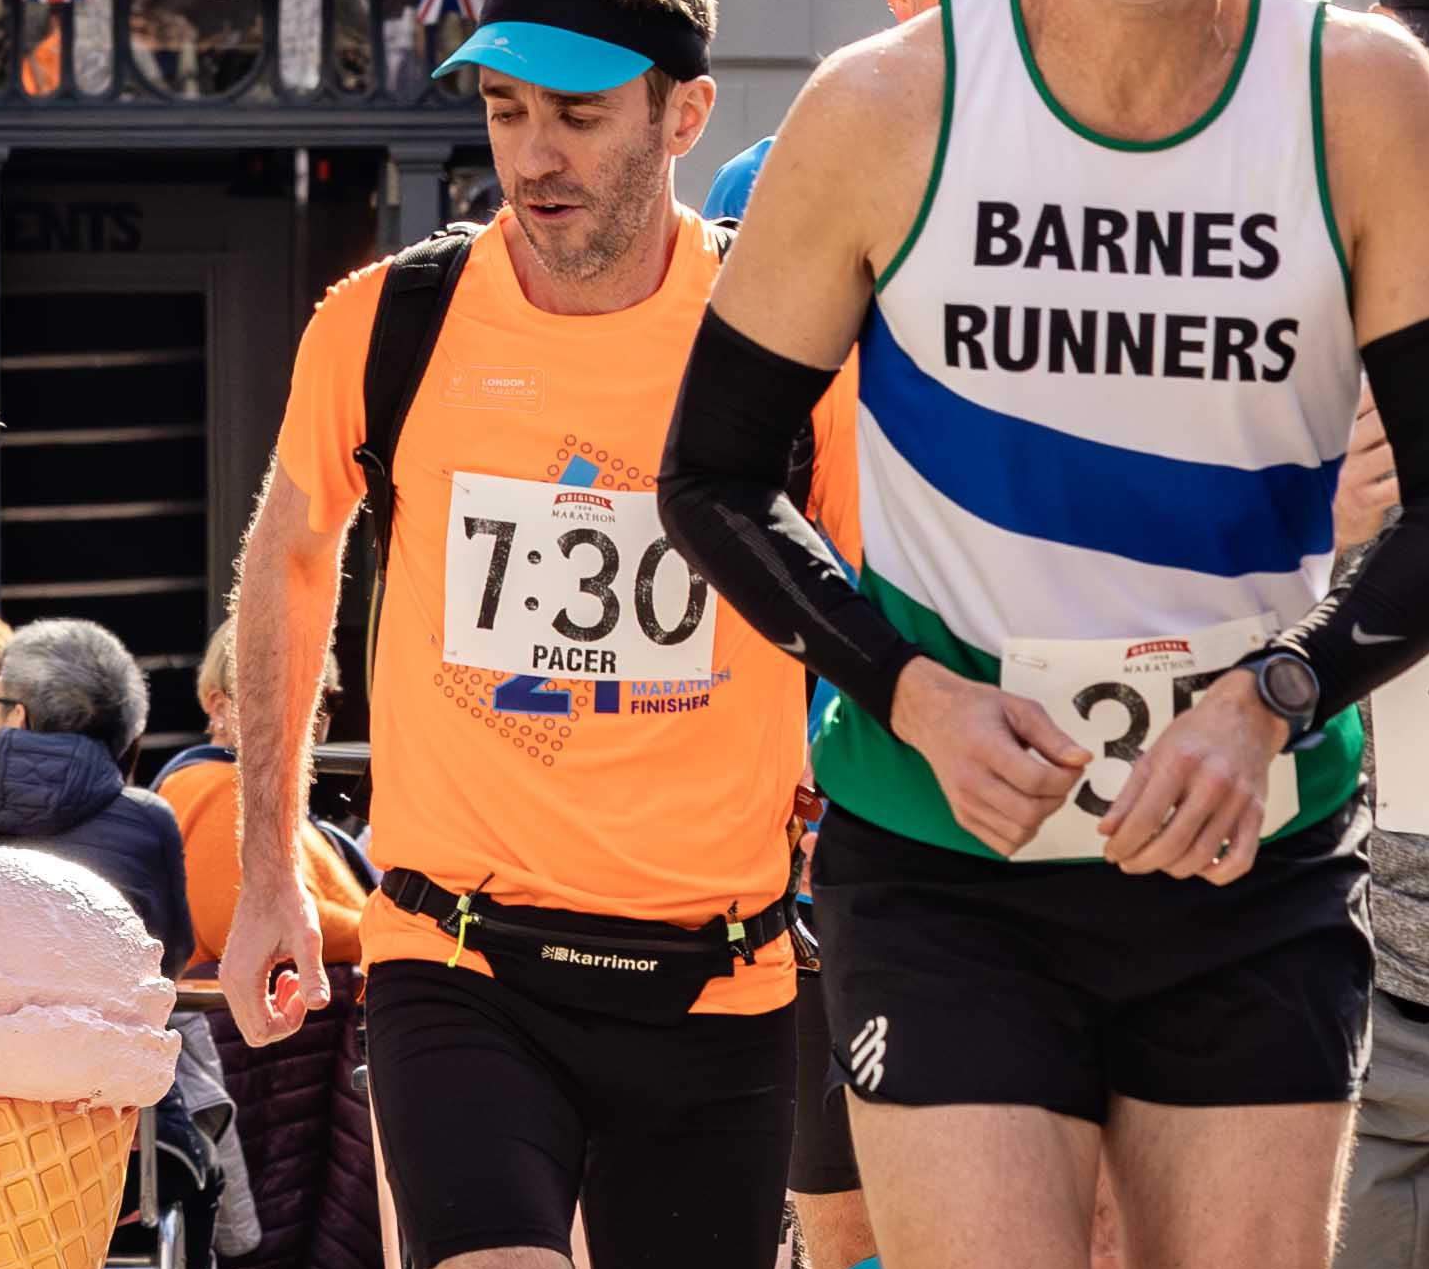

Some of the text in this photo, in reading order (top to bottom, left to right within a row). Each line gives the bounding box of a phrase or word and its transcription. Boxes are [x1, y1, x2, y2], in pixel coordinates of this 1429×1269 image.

[973, 201, 1279, 280] BARNES
[943, 303, 1299, 383] RUNNERS
[558, 493, 609, 507] ORIGINAL
[551, 510, 616, 523] MARATHON
[463, 516, 708, 646] 7:30
[532, 645, 616, 674] PACER
[630, 694, 710, 714] FINISHER
[569, 948, 658, 971] karrimor
